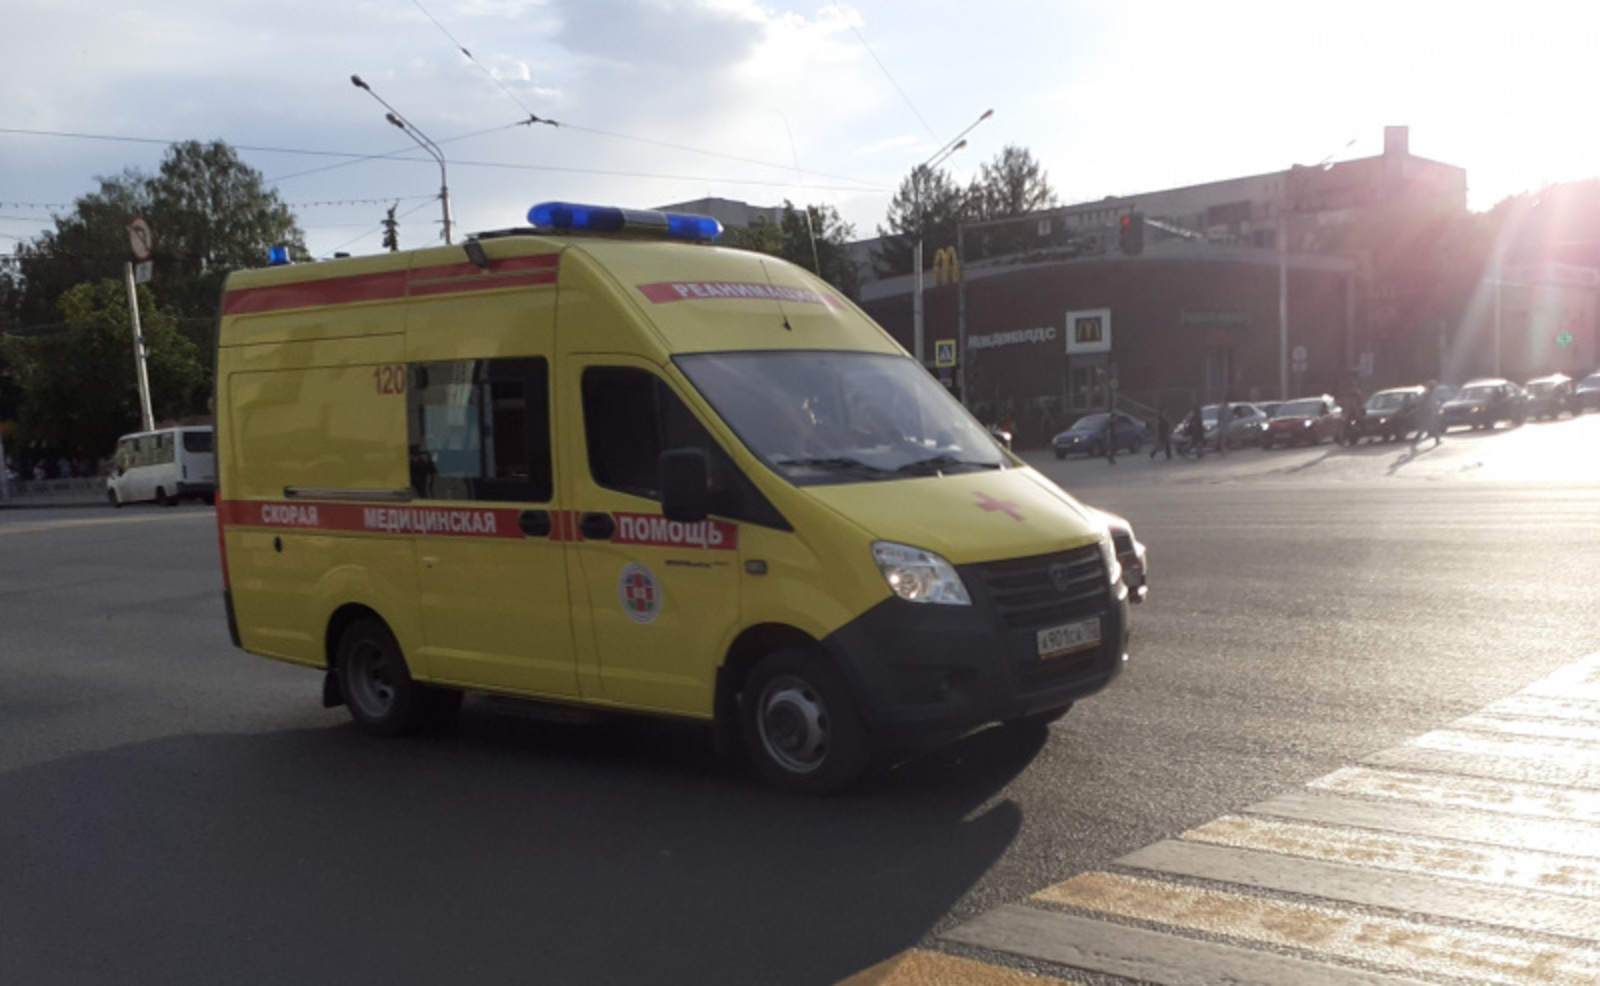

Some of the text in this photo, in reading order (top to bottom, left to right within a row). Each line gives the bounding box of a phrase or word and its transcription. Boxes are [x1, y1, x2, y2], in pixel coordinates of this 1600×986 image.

[373, 365, 406, 395] 120
[261, 504, 723, 549] СКОРАЯ МЕДИЦИНСКАЯ ПОМОЩЬ
